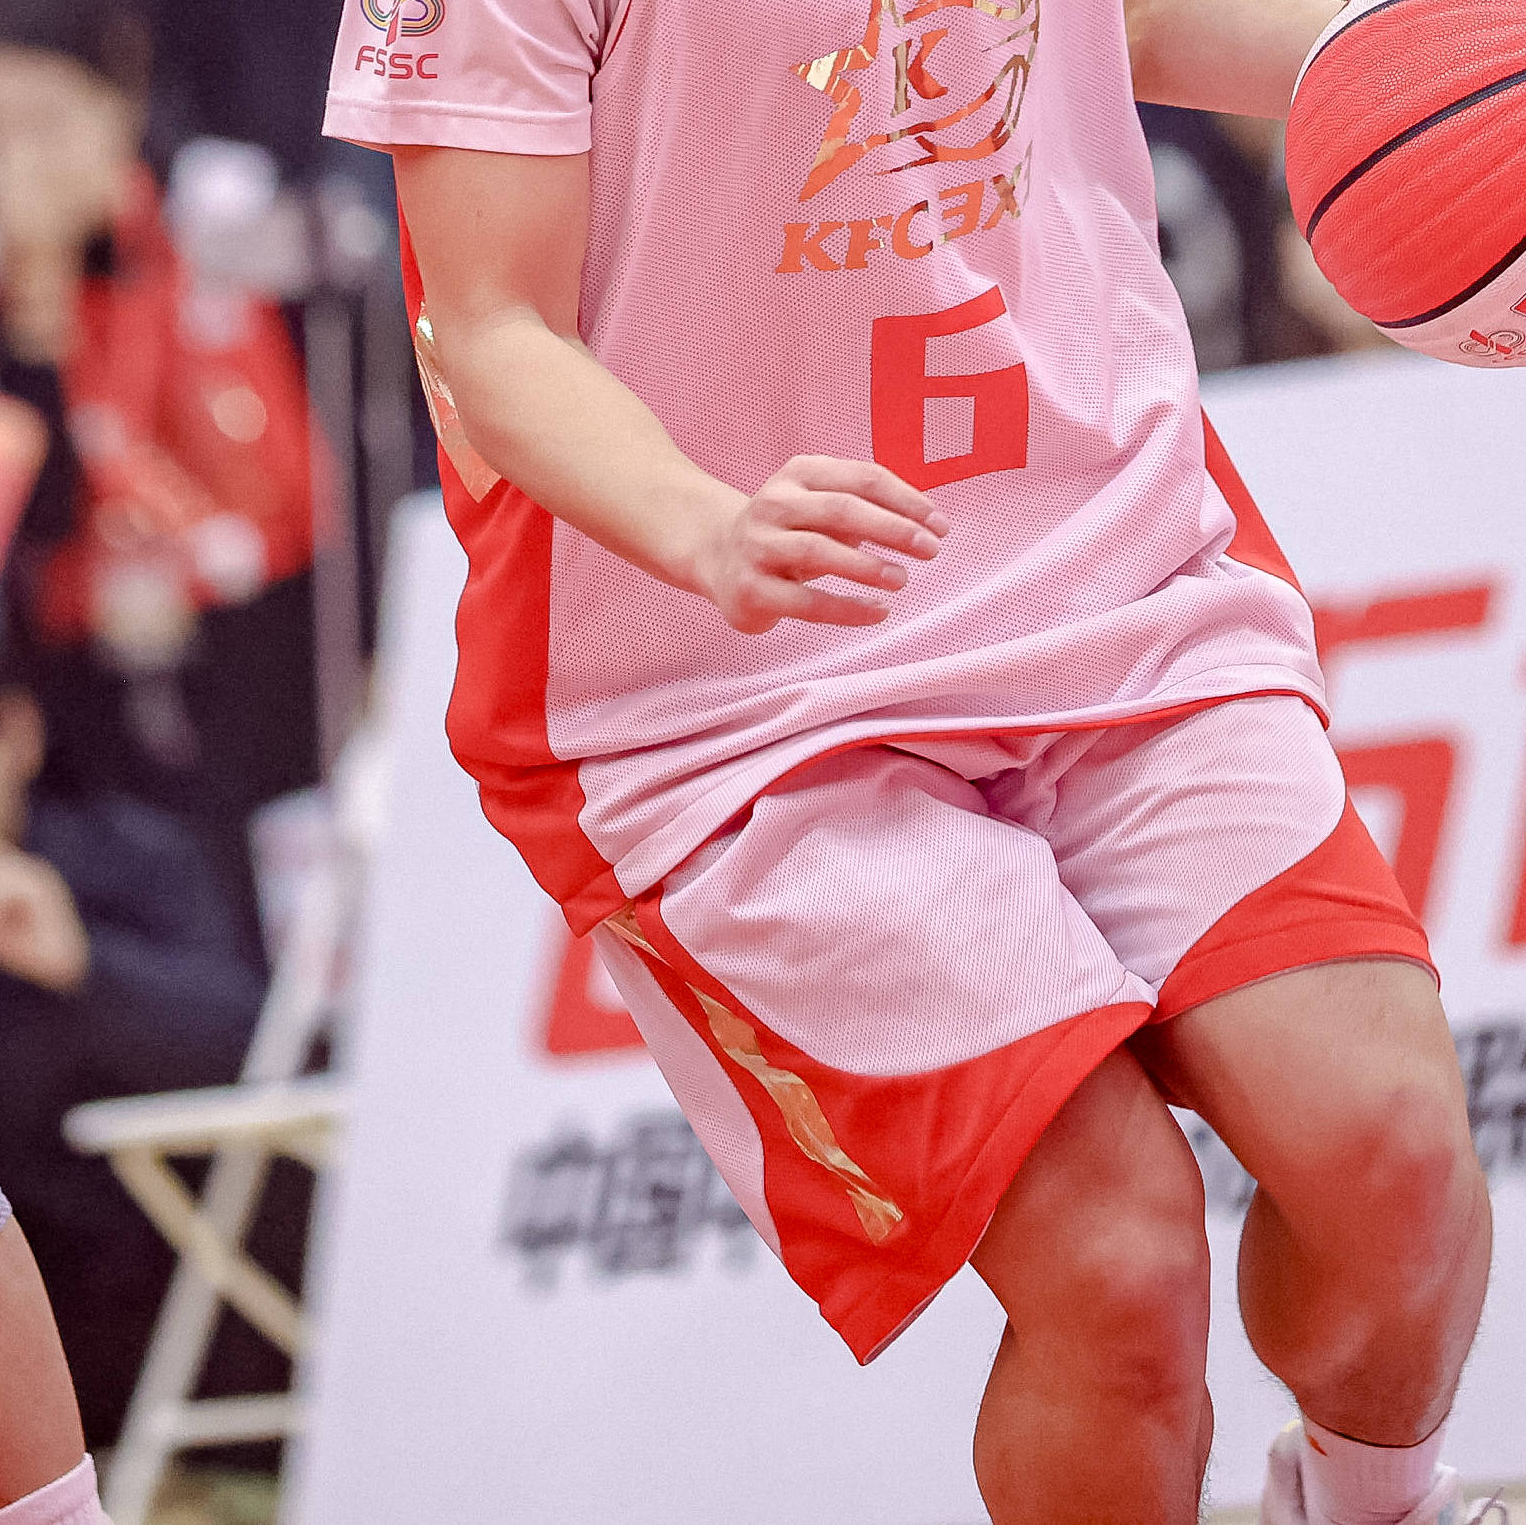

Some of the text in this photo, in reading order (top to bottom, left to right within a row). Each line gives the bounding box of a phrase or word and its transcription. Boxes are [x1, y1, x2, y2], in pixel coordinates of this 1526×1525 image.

[354, 45, 439, 81] FSSC
[889, 27, 948, 120] K
[871, 284, 1029, 493] 6
